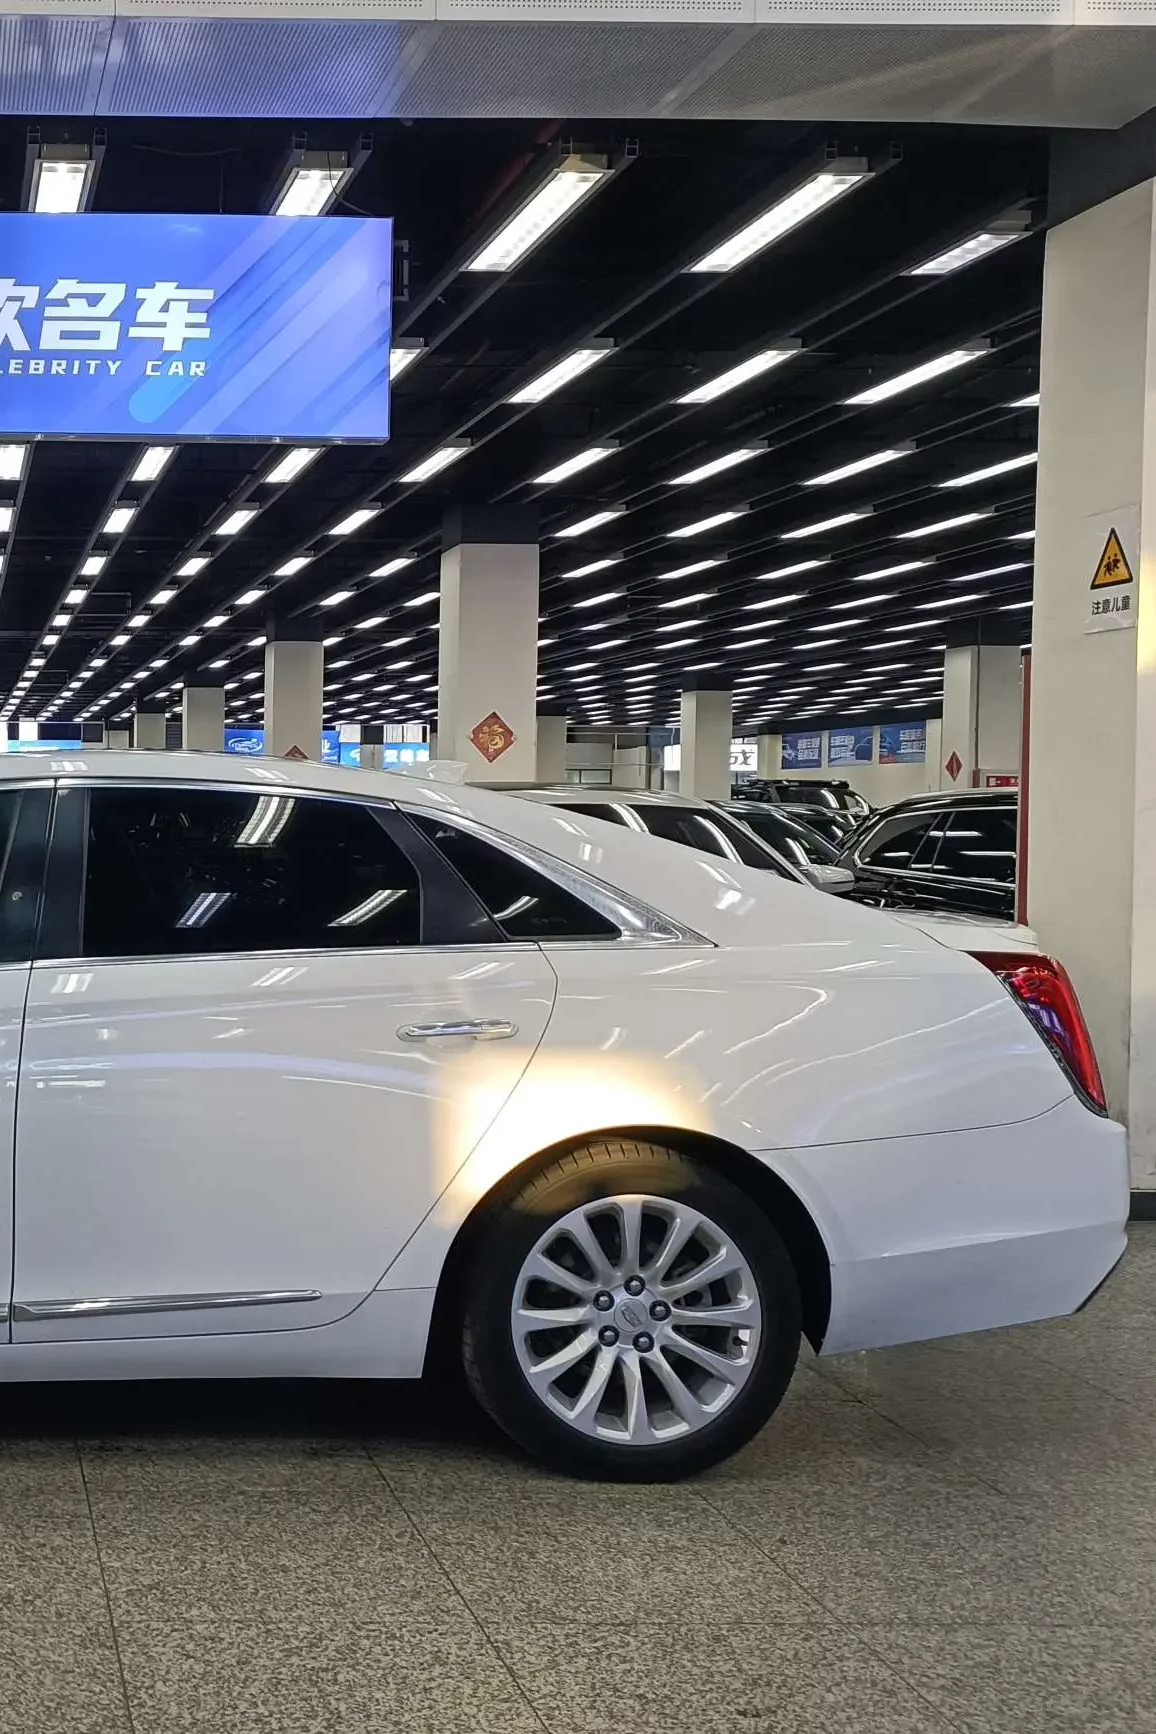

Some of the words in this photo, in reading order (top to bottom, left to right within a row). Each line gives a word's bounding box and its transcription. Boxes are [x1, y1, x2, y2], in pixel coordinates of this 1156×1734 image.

[144, 361, 206, 377] CAR
[1091, 595, 1131, 616] 注意儿童
[479, 724, 505, 752] 福
